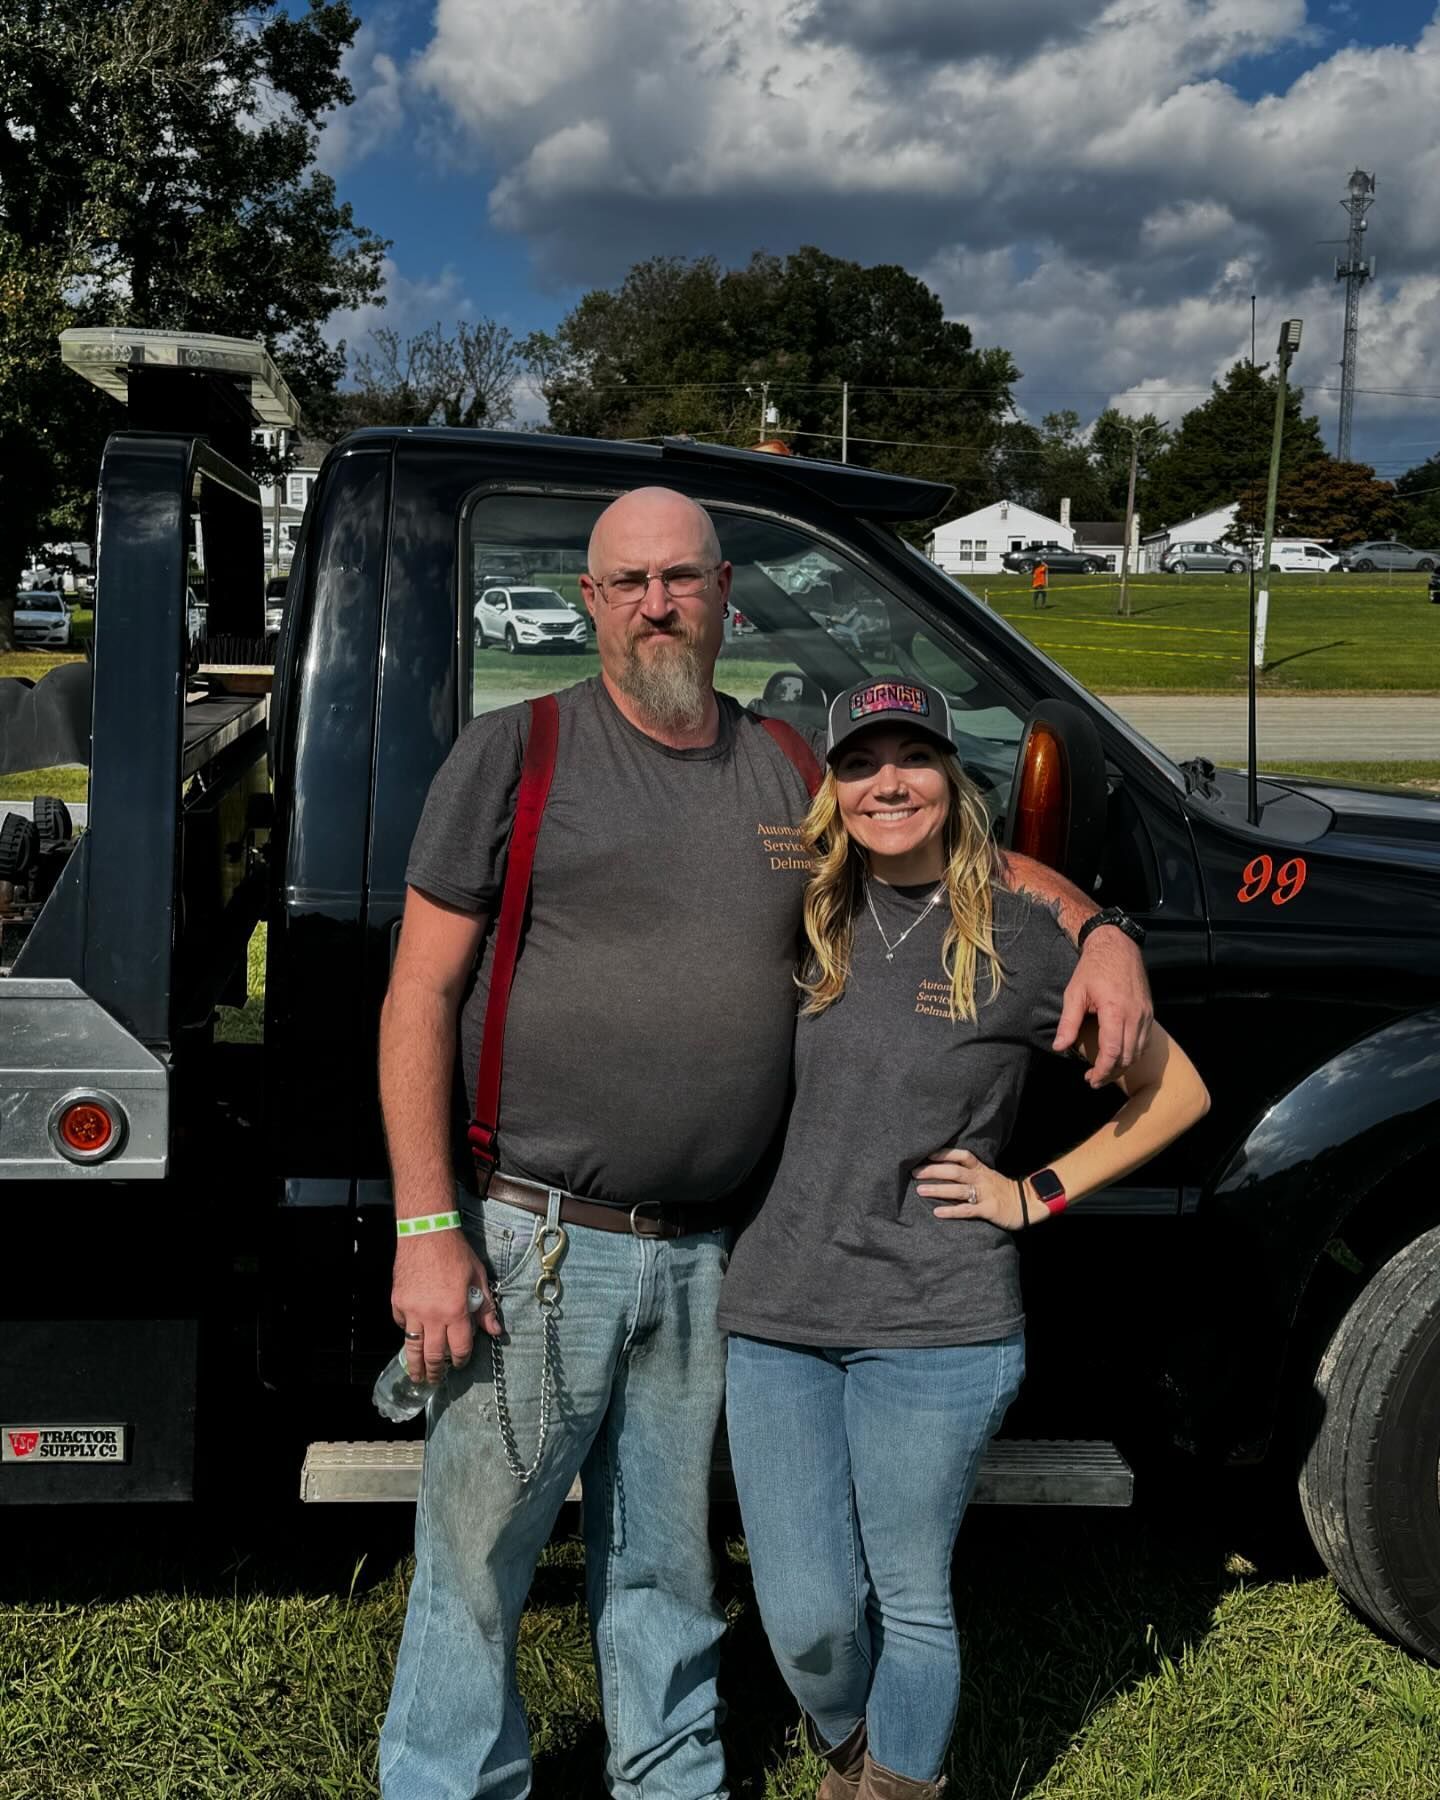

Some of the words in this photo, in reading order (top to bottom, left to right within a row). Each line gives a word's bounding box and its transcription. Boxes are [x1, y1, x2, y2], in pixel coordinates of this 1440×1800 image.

[854, 685, 926, 709] BURNISH
[757, 823, 804, 836] Autom
[770, 857, 812, 870] Delma
[1237, 854, 1307, 906] 99
[918, 978, 952, 991] Autom
[916, 991, 950, 1004] Servic
[40, 1430, 117, 1444] TRACTOR
[40, 1444, 98, 1457] SUPPLY
